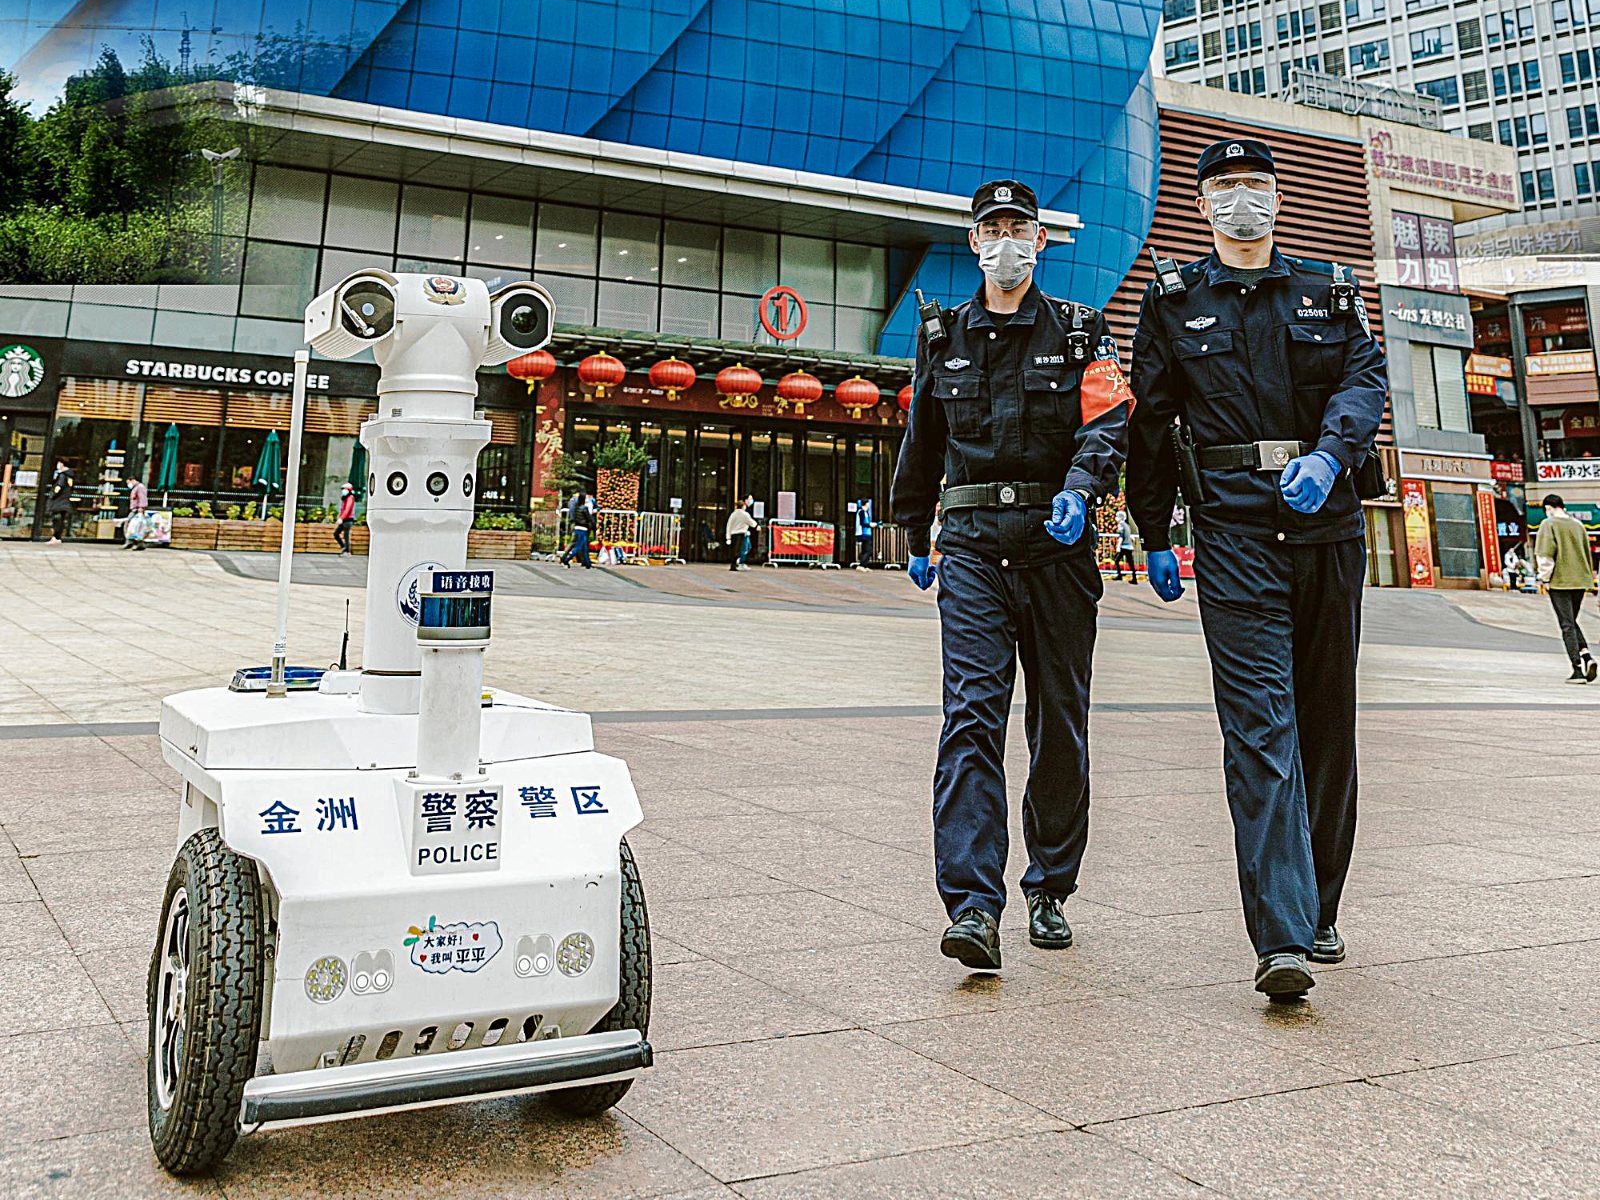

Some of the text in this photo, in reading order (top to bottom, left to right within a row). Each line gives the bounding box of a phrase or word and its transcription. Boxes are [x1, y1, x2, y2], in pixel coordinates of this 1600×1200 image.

[126, 359, 330, 390] STARBUCKS COFEE
[441, 575, 490, 590] 语音接收
[258, 785, 609, 834] 金洲 警区
[421, 789, 499, 834] 警察
[418, 842, 498, 866] POLICE
